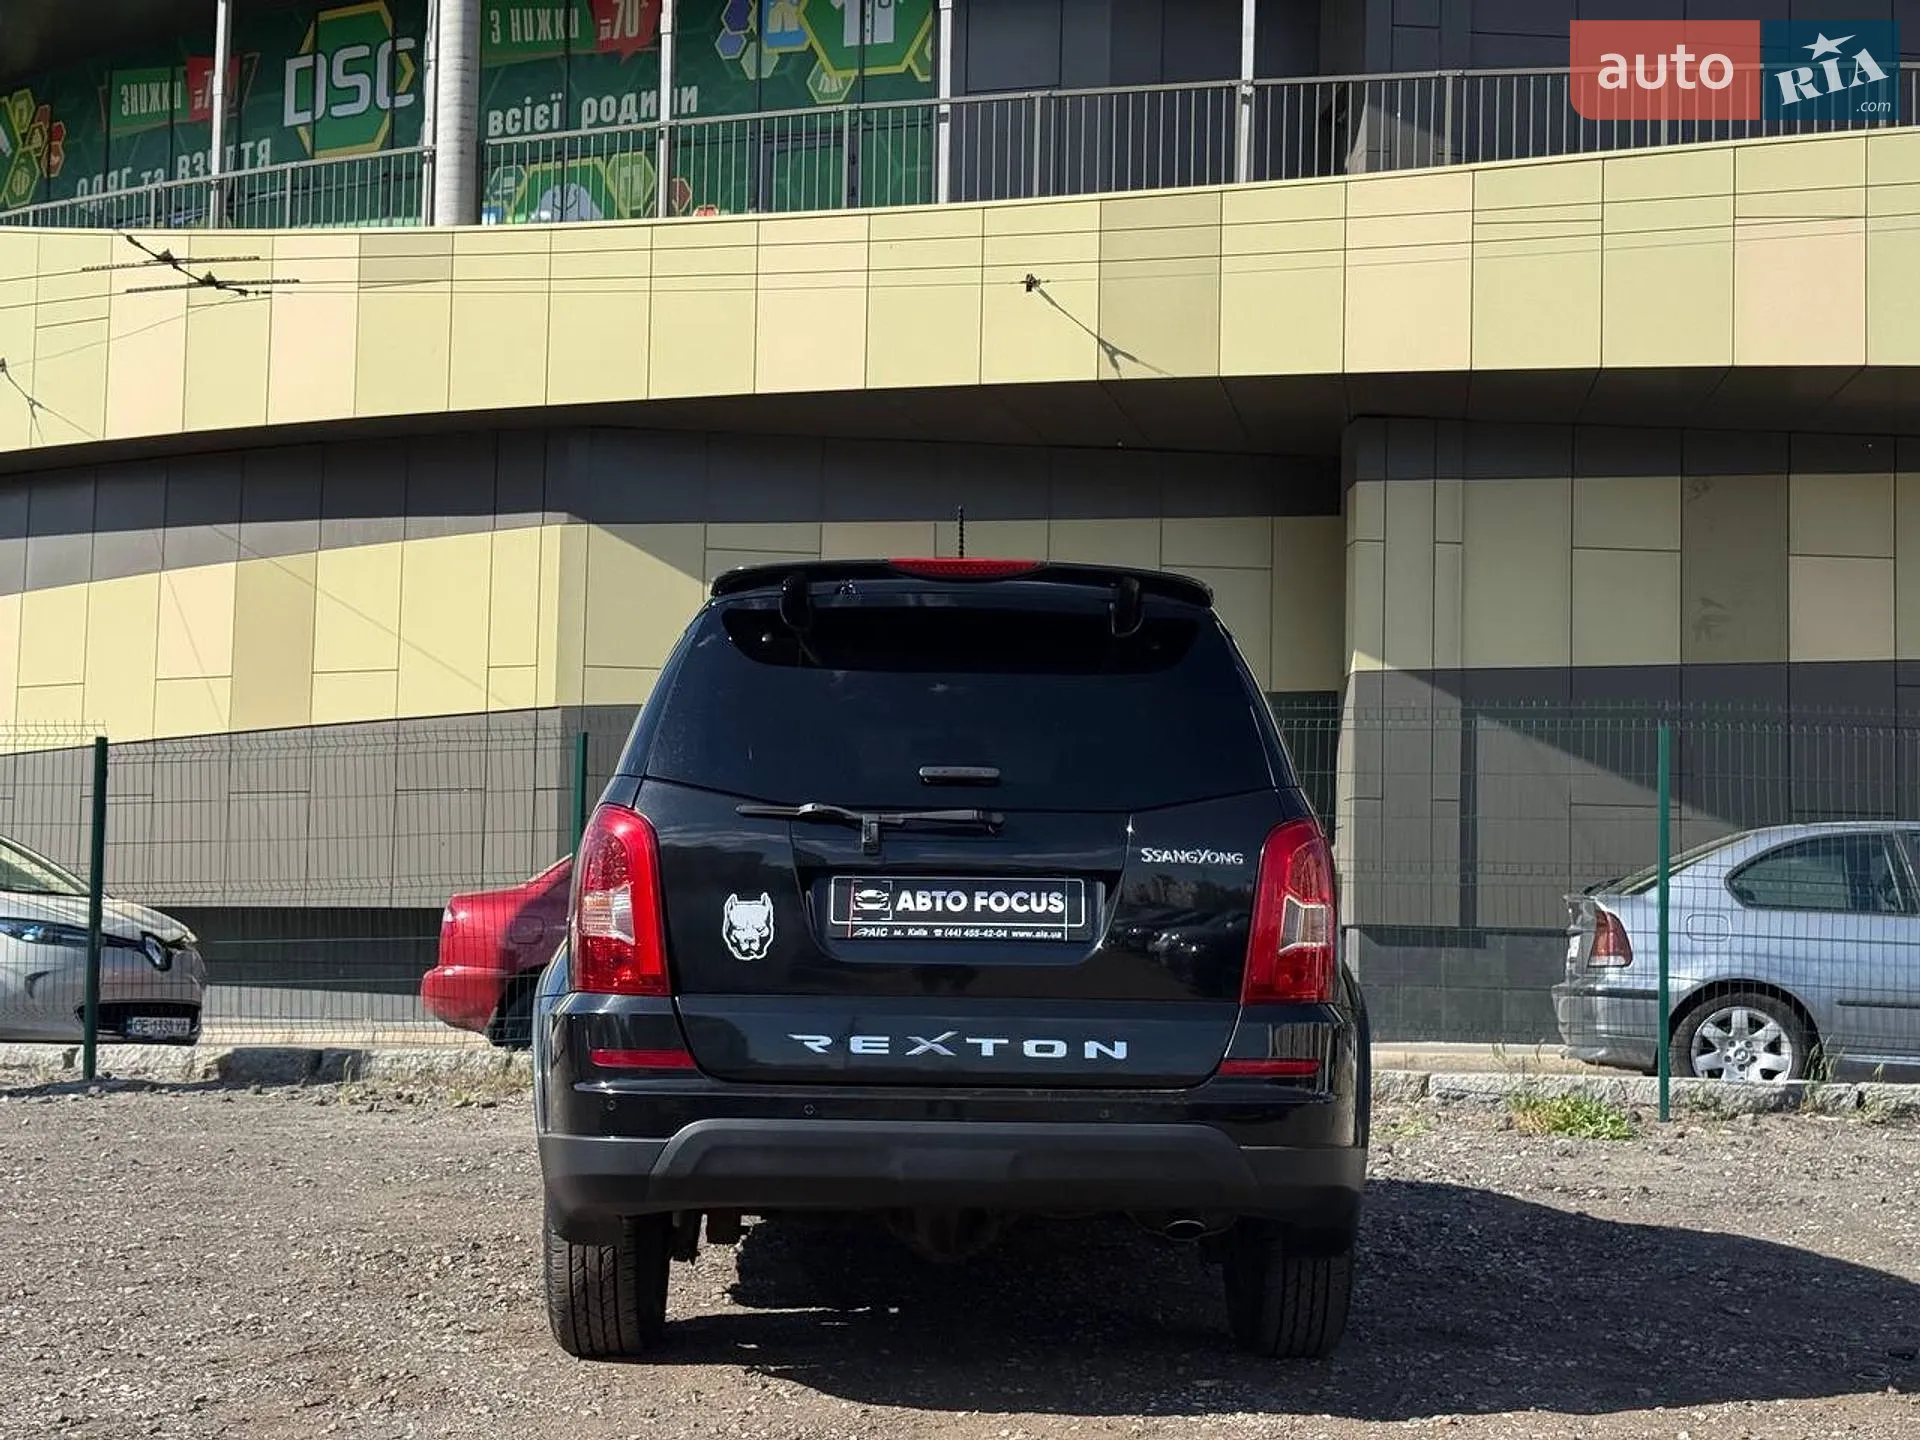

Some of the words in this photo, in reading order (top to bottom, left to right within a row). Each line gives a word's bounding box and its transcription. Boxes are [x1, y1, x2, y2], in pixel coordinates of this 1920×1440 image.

[283, 37, 416, 128] DSC
[487, 92, 564, 138] всієї
[895, 890, 968, 912] АВТО
[974, 891, 1065, 914] FOCUS
[788, 1030, 1128, 1060] REXTON
